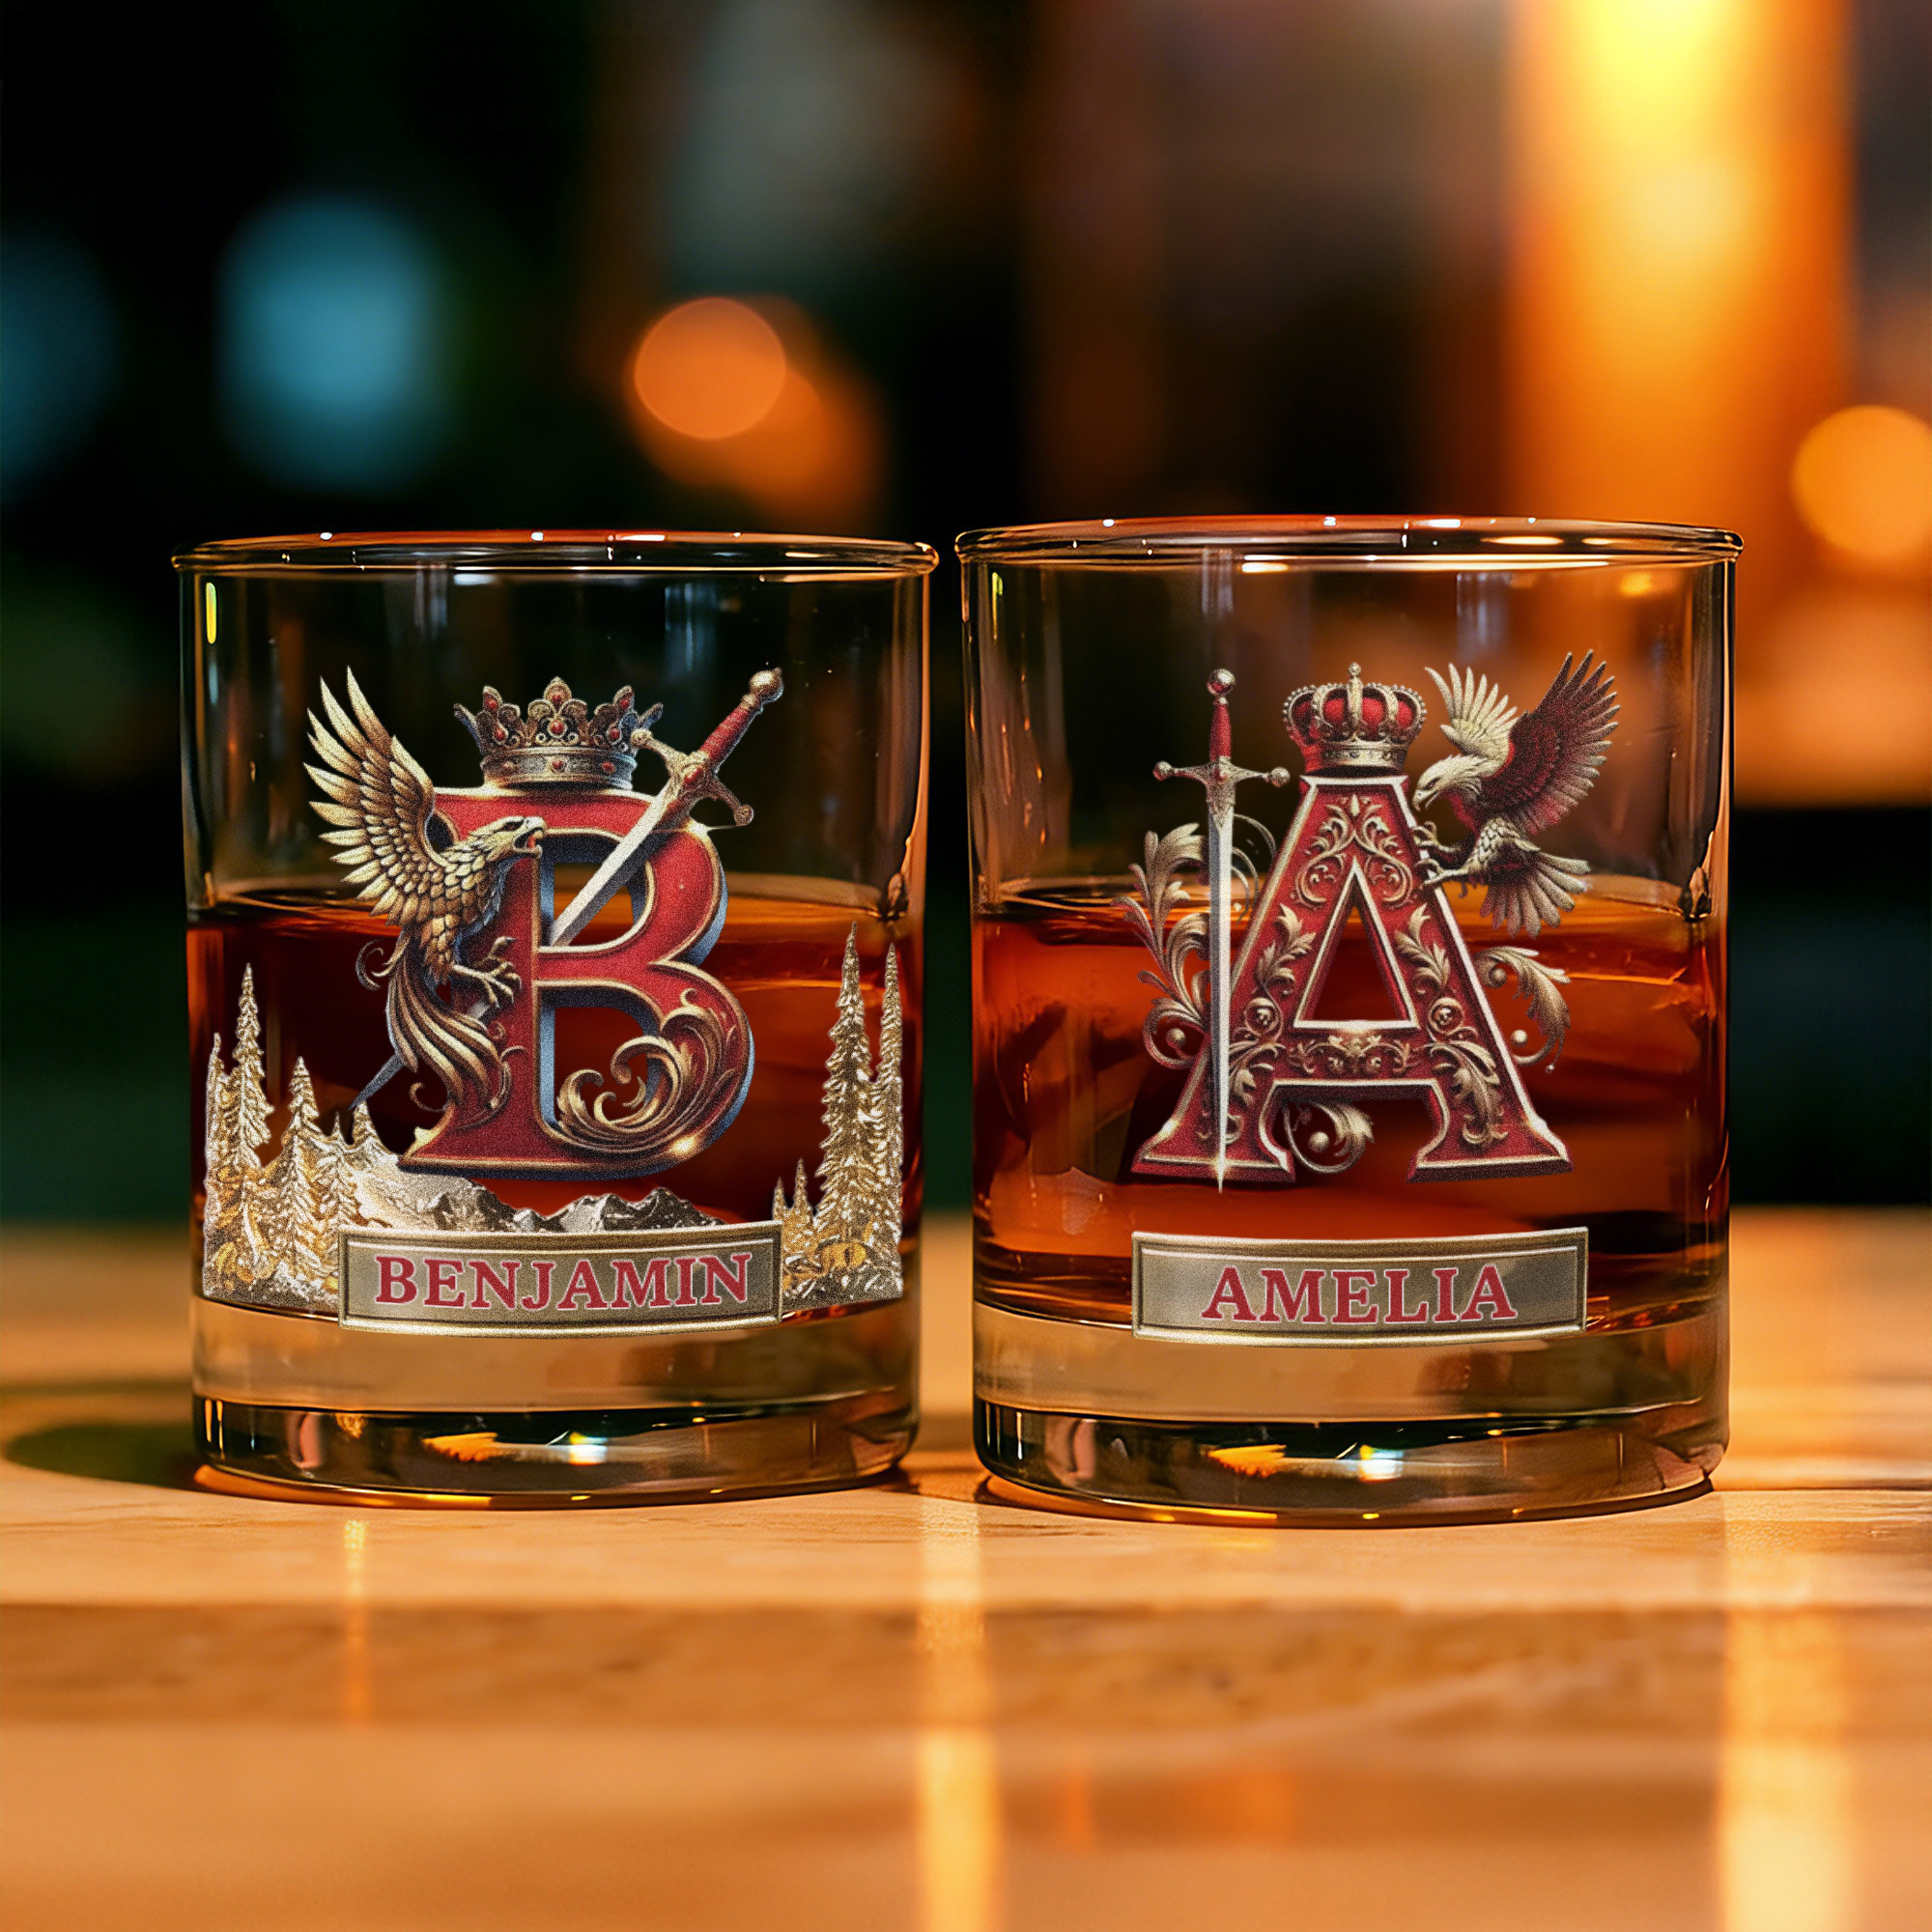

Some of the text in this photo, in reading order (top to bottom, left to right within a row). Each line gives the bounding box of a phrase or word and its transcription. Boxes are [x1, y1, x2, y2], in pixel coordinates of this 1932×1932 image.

[398, 785, 755, 1179] B
[1131, 775, 1574, 1182] A
[375, 1253, 753, 1310] BENJAMIN
[1200, 1264, 1518, 1324] AMELIA
